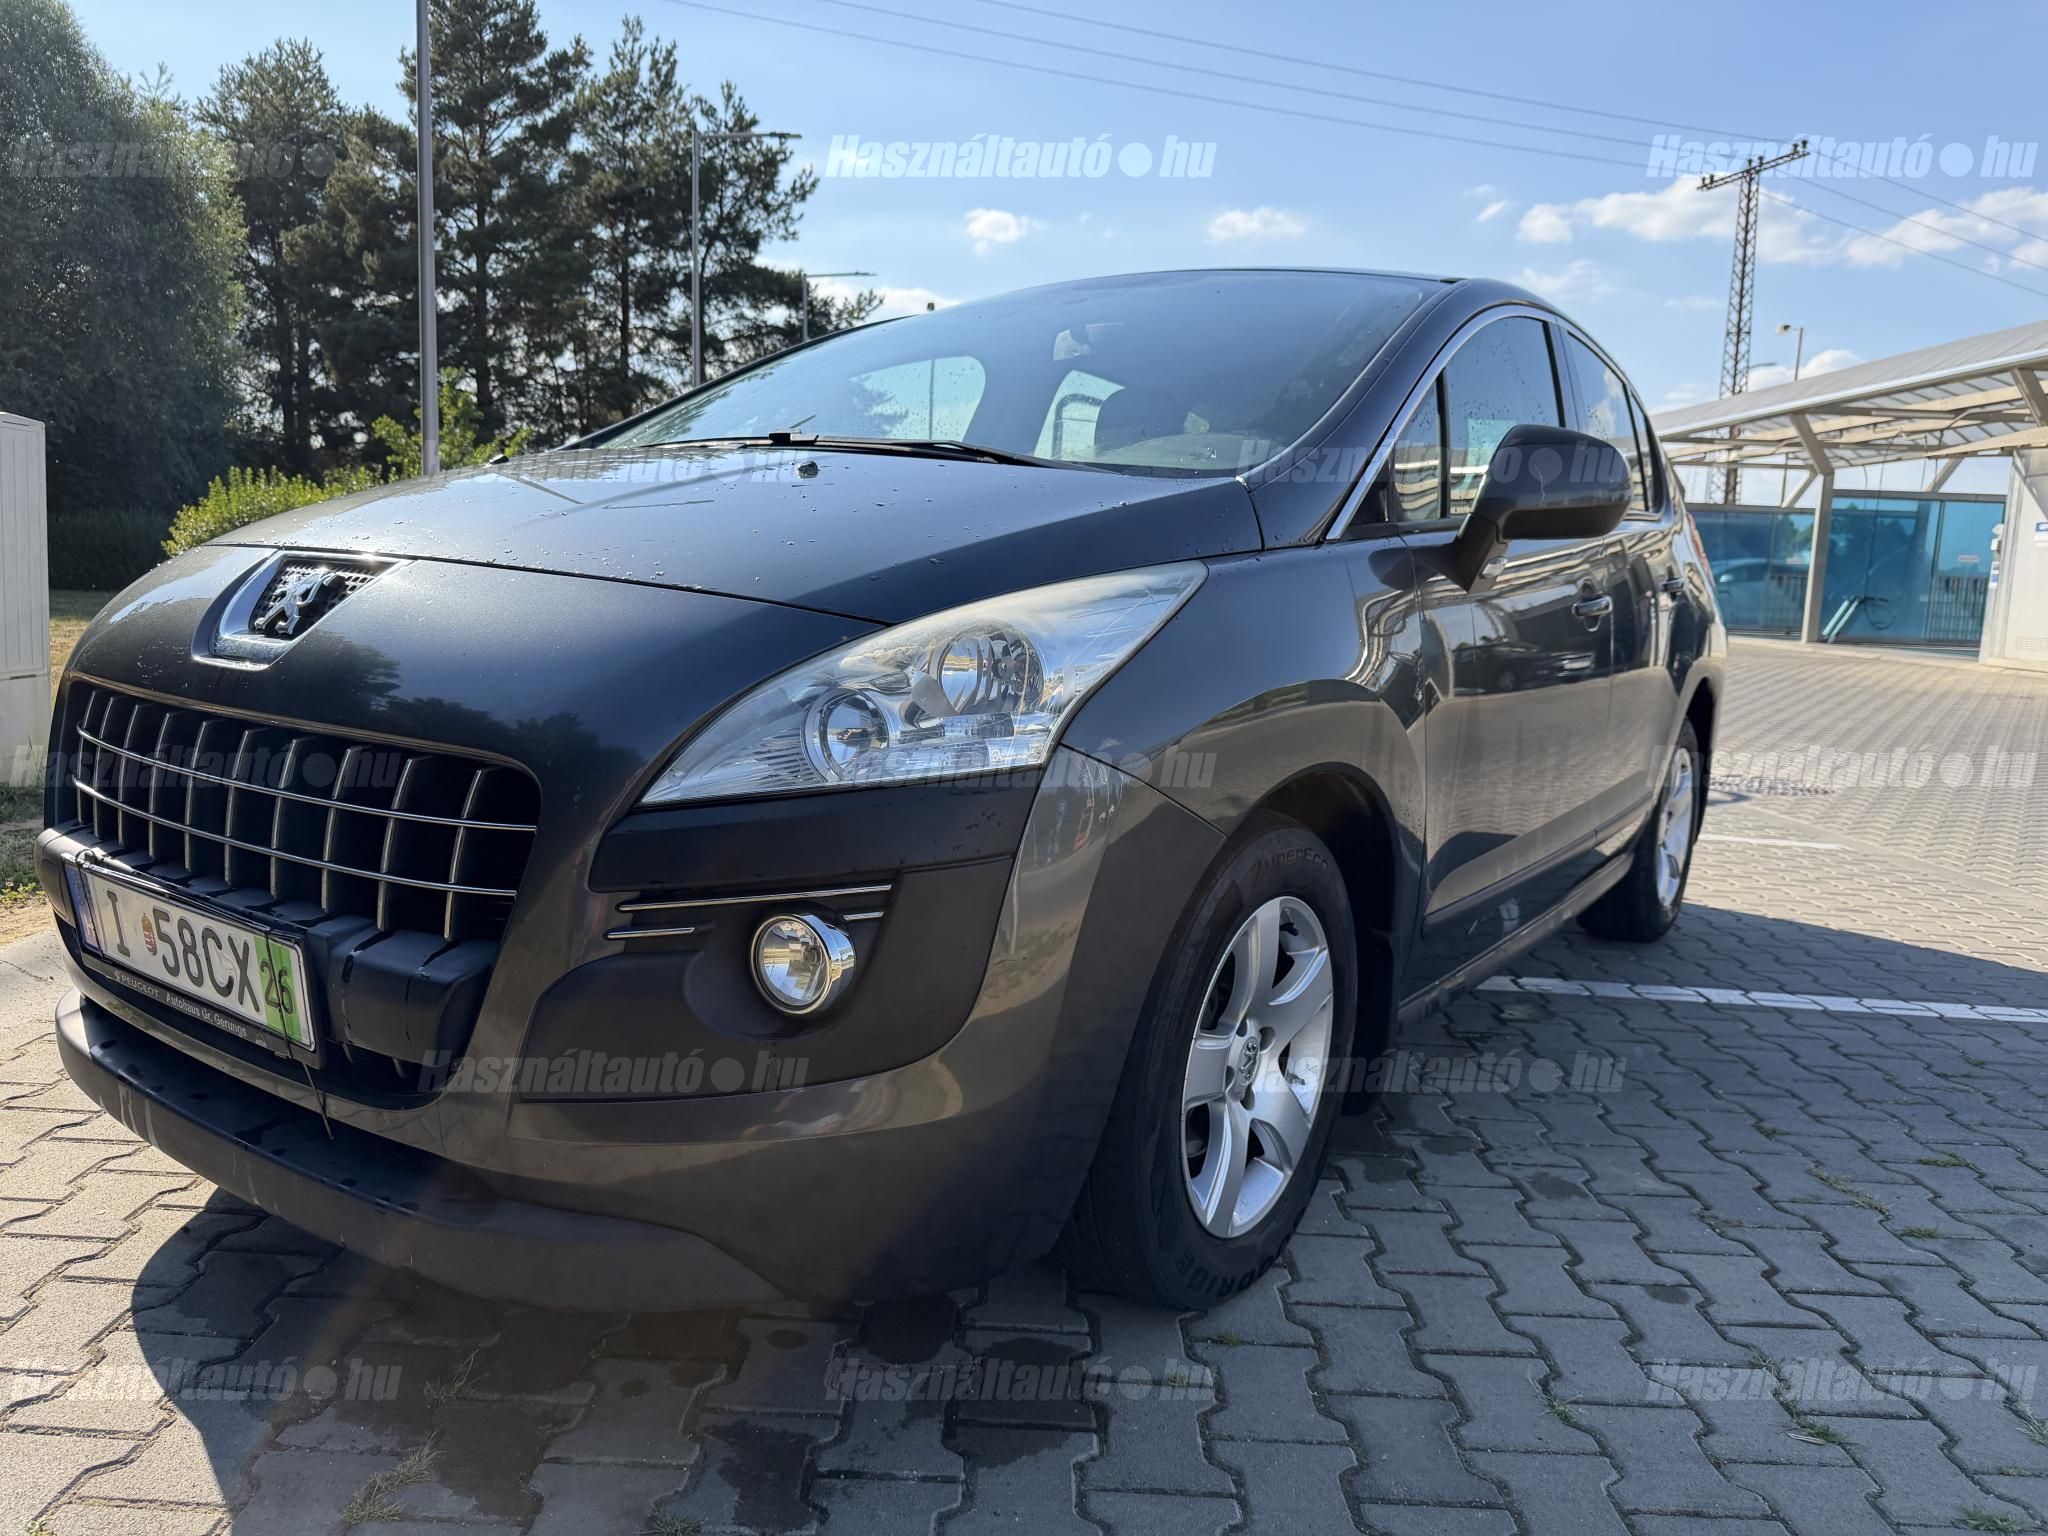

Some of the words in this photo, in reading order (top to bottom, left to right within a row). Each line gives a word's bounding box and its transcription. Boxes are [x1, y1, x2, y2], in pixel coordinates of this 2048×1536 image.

[106, 890, 131, 957] I
[153, 907, 260, 1012] 58CX
[260, 960, 295, 1015] 26
[121, 974, 159, 998] PEUGEOT
[166, 992, 200, 1016] Autohaus
[214, 1013, 247, 1037] Gerungs
